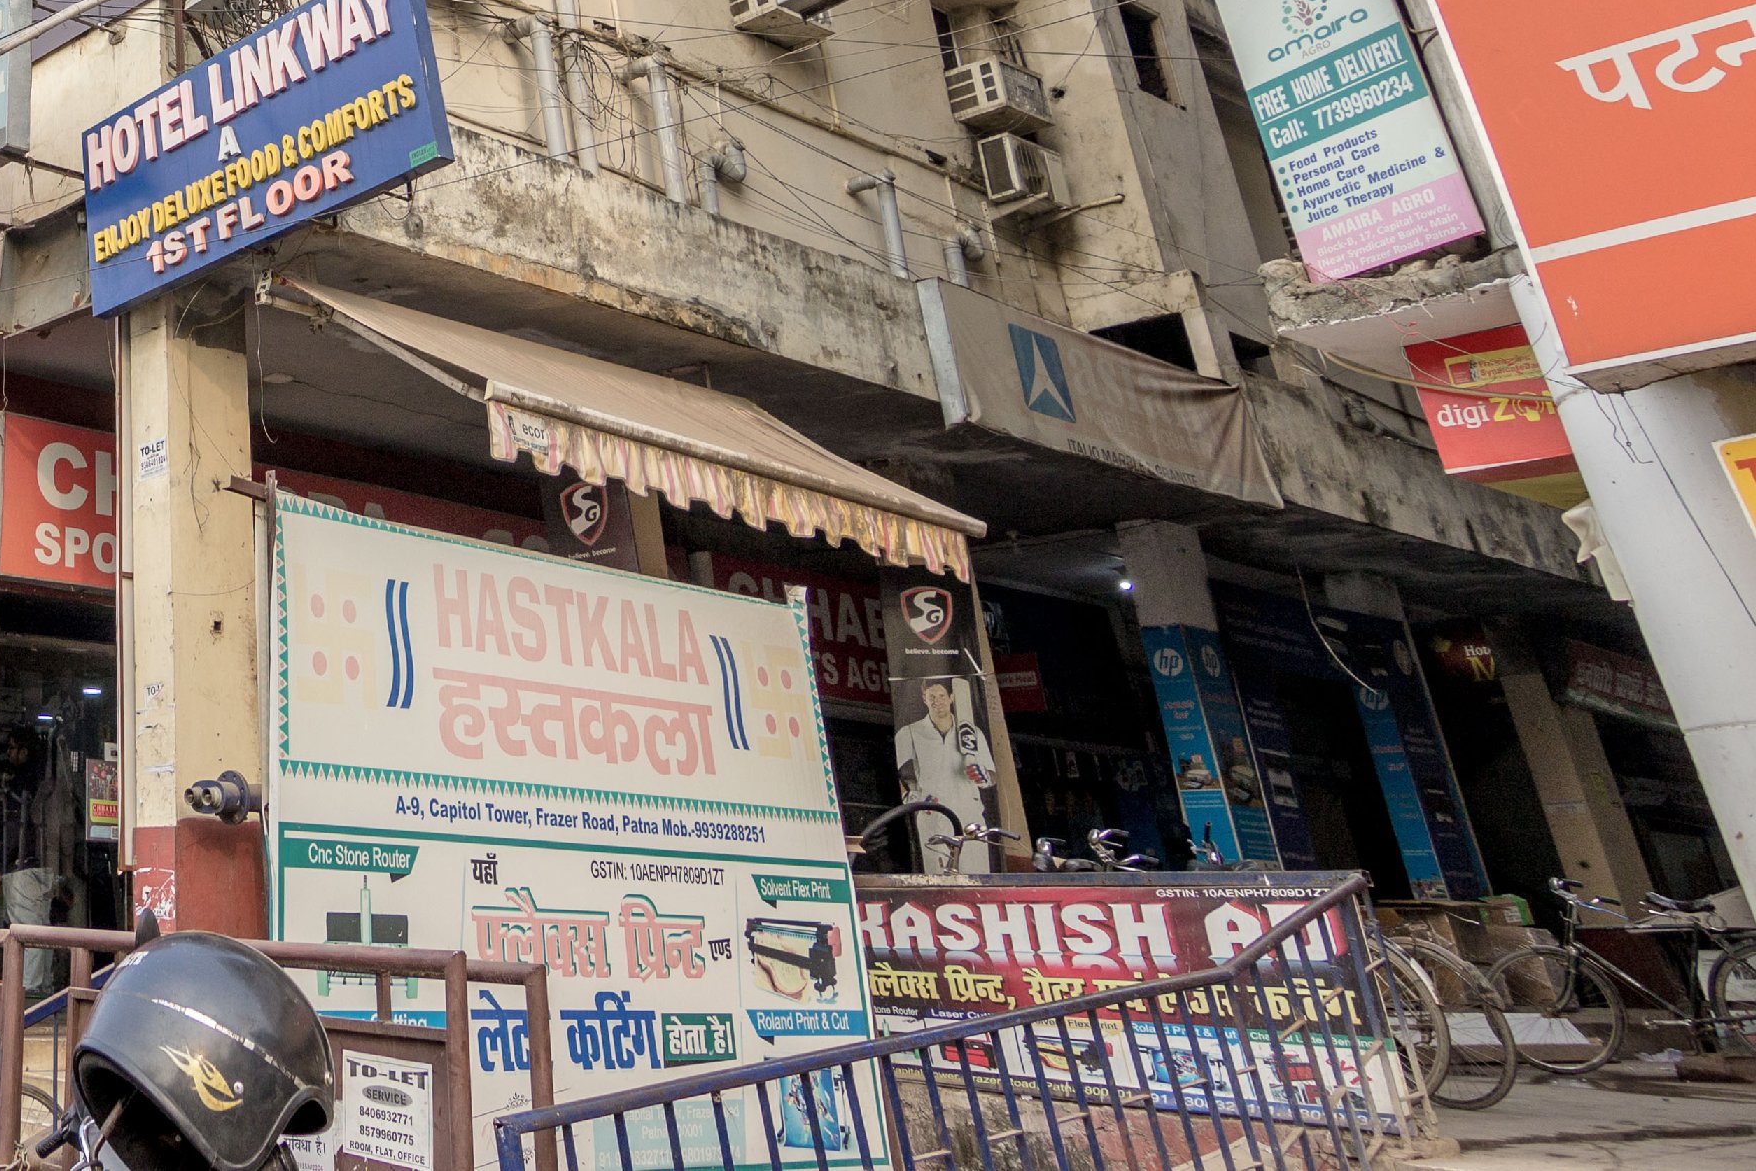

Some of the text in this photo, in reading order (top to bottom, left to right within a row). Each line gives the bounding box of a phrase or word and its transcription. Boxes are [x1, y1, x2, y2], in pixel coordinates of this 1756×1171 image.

[1299, 38, 1332, 59] AGRO
[1253, 33, 1406, 120] FREE HOME DELIVERY
[86, 69, 209, 195] HOTEL
[1267, 71, 1415, 150] Call: 7739960234
[215, 119, 241, 165] A
[1287, 127, 1378, 172] Food Products
[1291, 140, 1380, 185] Personal Care
[93, 69, 417, 265] ENJOY DELUXE FOOD & COMFORTS
[1296, 161, 1366, 197] Home Care
[1300, 145, 1446, 211] Ayurvedic Medicine &
[145, 144, 355, 278] 1ST FLOOR
[1305, 181, 1397, 224] Juice Therapy
[1319, 187, 1437, 241] AMAIRA AGRO
[1343, 230, 1397, 259] Syndicate
[1427, 208, 1459, 228] Main
[140, 441, 165, 457] TO-LET
[433, 562, 709, 686] HASTKALA
[432, 667, 720, 779] हस्तकला
[394, 793, 767, 845] A-9, Capitol Tower, Frazer Road, Patna Mob.-9939288251
[307, 842, 411, 870] Cnc Stone Router
[470, 850, 499, 887] यहाँ
[589, 860, 727, 889] GSTIN: 10AENPH7809D1ZT
[759, 877, 832, 901] Solvent Flex Print
[1156, 888, 1200, 899] GSTIN:
[616, 892, 712, 986] प्रिन्ट
[858, 902, 1176, 960] KASHISH
[557, 988, 661, 1076] कटिंग
[755, 1011, 851, 1033] Roland Print & Cut
[892, 1007, 919, 1018] Router
[931, 1009, 962, 1020] Laser
[665, 1018, 710, 1058] होता
[346, 1058, 429, 1091] TO-LET
[359, 1105, 413, 1127] 8406932771
[365, 1087, 407, 1106] SERVICE
[349, 1140, 426, 1166] ROOM, FLAT, OFFICE
[359, 1124, 414, 1146] 8579960775
